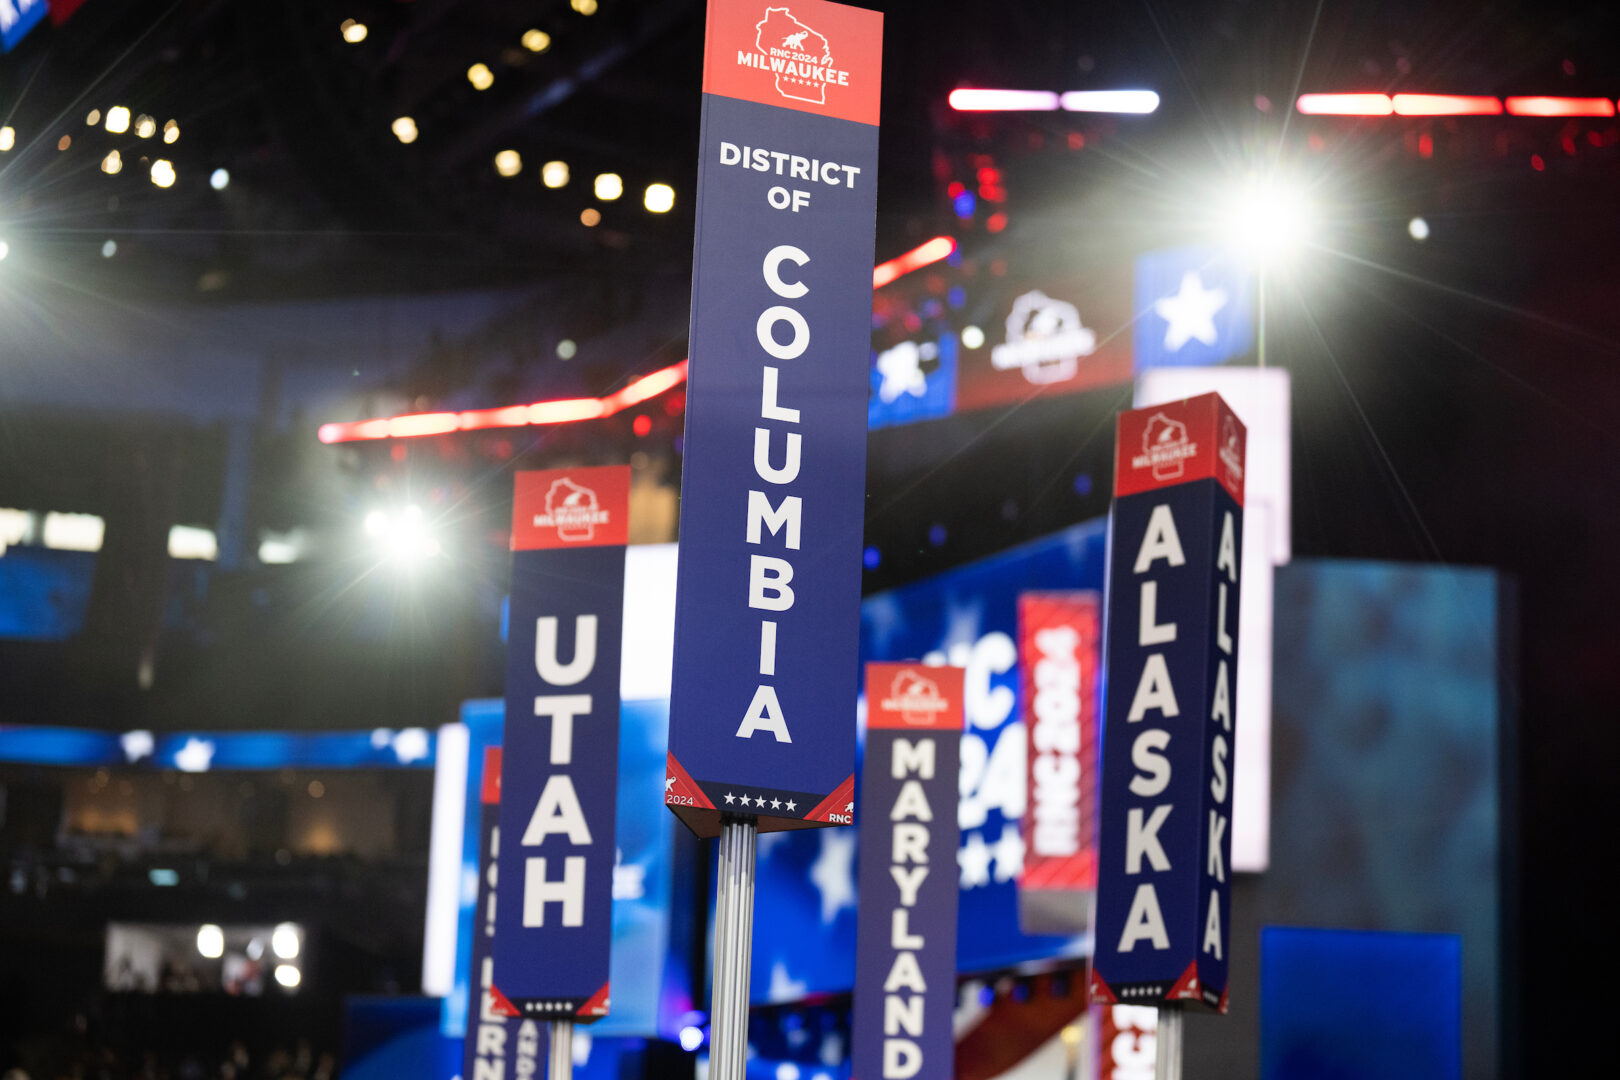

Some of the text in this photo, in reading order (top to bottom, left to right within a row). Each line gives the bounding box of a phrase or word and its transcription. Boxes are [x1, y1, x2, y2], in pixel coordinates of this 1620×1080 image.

[737, 50, 850, 87] MILWAUKEE
[770, 47, 818, 65] RNC 2024
[719, 141, 861, 189] DISTRICT
[767, 186, 811, 213] OF
[735, 244, 811, 744] COLUMBIA
[1117, 504, 1186, 953] ALASKA
[1202, 510, 1237, 961] ALASKA
[521, 614, 599, 929] UTAH
[666, 794, 694, 806] 2024
[828, 813, 852, 825] RNC
[882, 738, 936, 1080] MARYLAND
